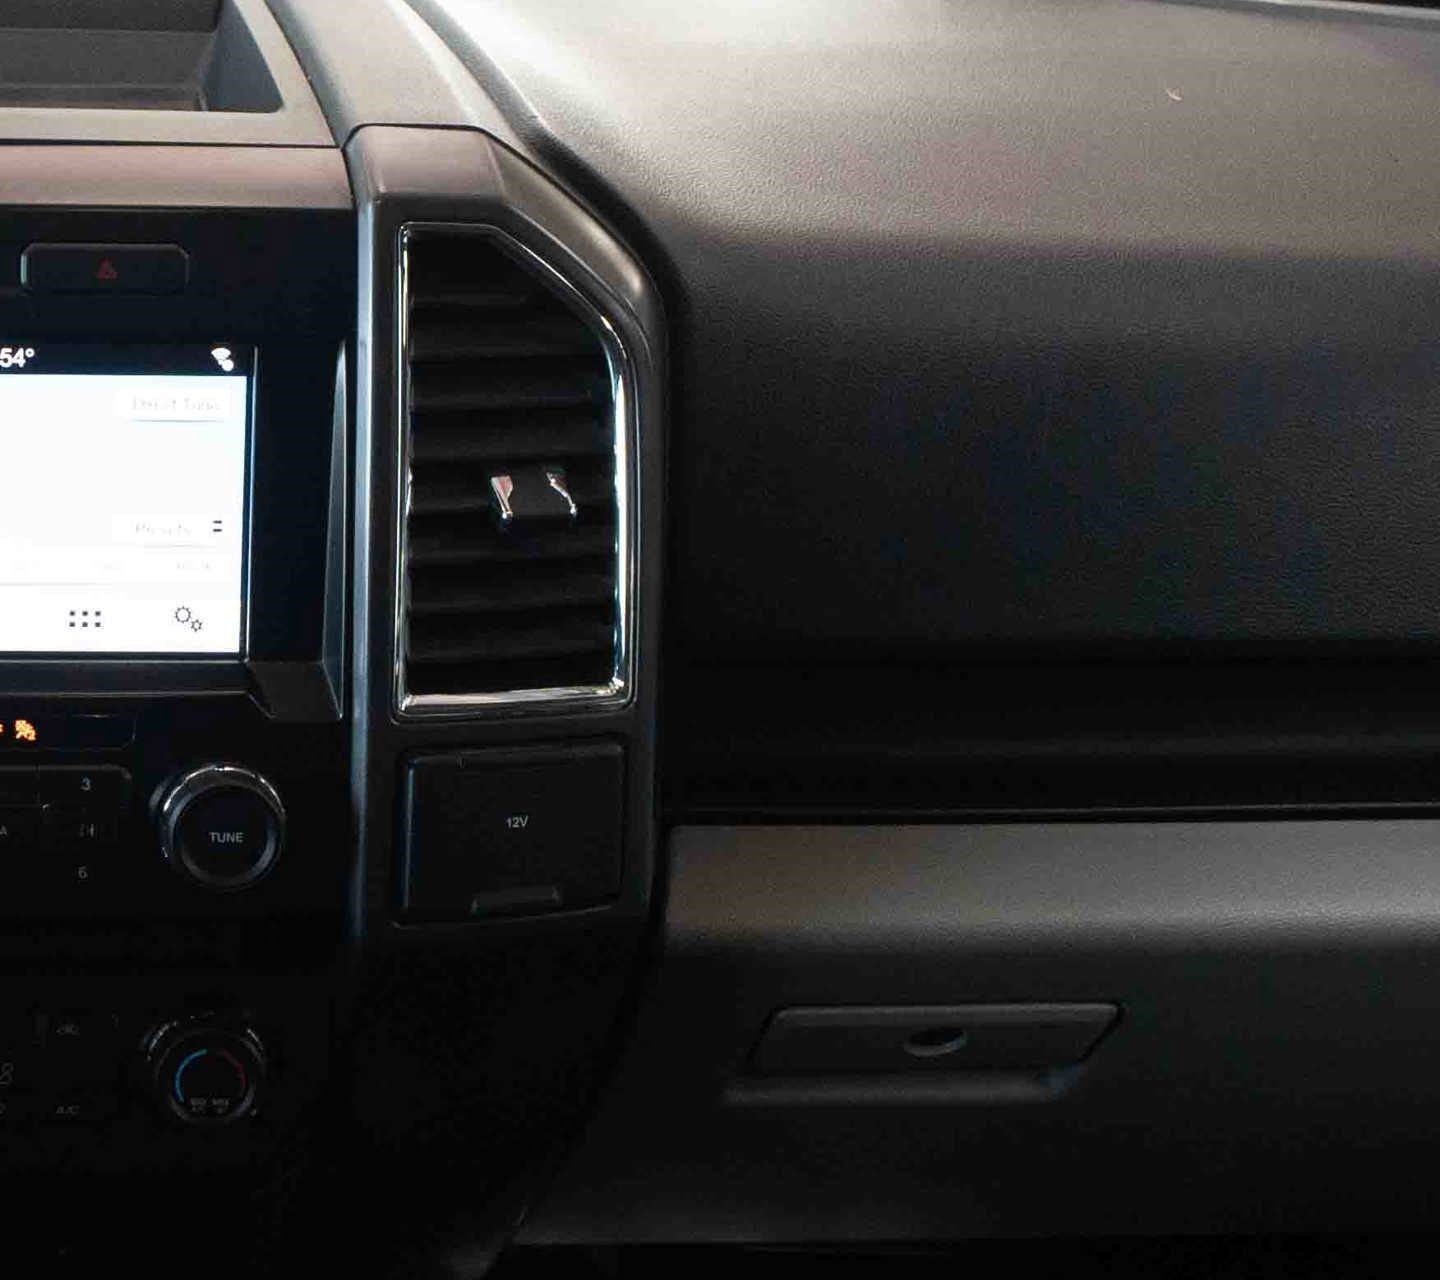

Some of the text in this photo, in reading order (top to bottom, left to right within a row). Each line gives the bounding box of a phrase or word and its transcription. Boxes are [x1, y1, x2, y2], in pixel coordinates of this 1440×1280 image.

[0, 346, 35, 368] 54°
[81, 777, 91, 791] 3
[505, 815, 528, 829] 12V
[210, 831, 243, 844] TUNE
[78, 866, 88, 879] 6
